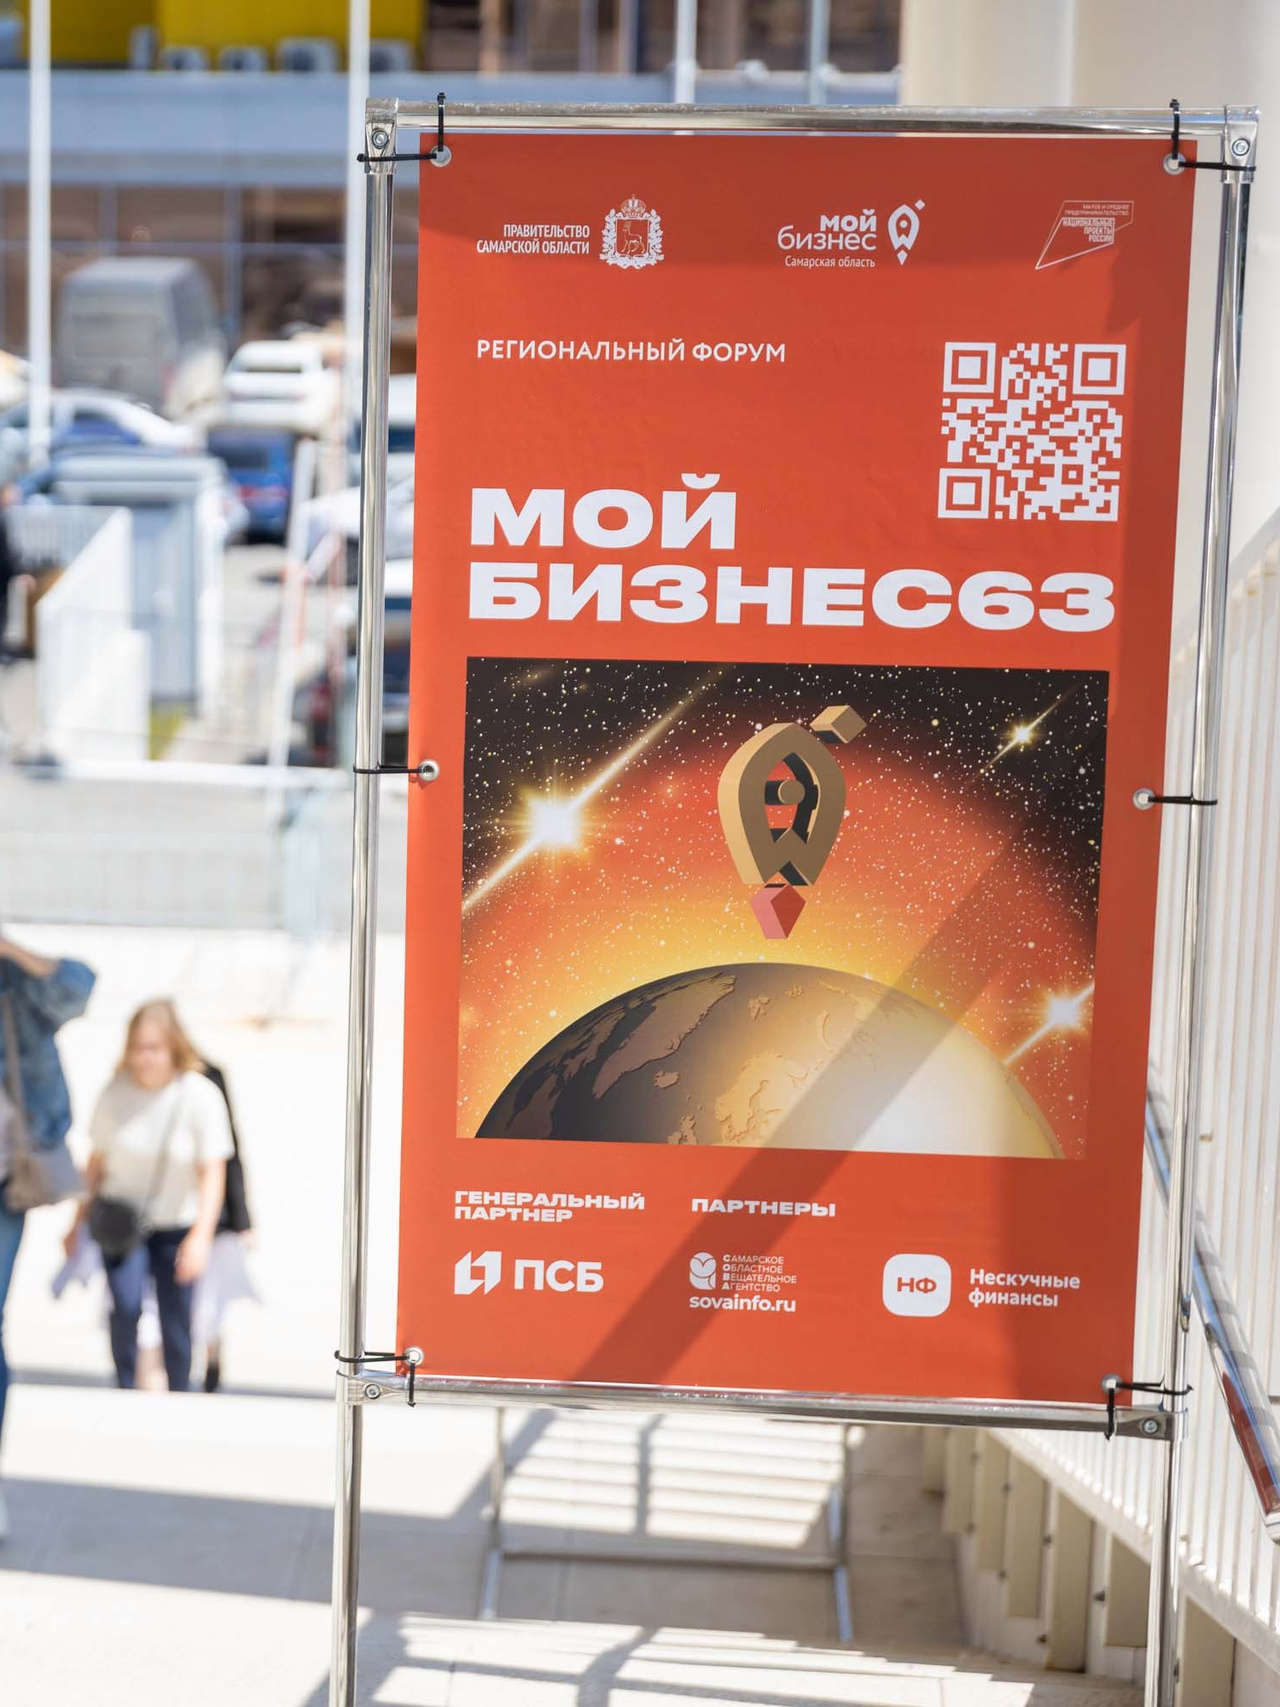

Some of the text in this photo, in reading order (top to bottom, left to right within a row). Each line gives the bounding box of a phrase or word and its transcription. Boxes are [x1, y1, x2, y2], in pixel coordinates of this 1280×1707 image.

[820, 208, 877, 232] мой
[503, 224, 590, 238] ПРАВИТЕЛЬСТВО
[777, 225, 877, 251] бизнес
[476, 238, 590, 254] САМАРСКОЙ ОБЛАСТИ
[785, 255, 876, 269] Самарская область
[477, 338, 786, 362] РЕГИОНАЛЬНЫЙ ФОРУМ
[470, 473, 737, 550] МОЙ
[468, 562, 1115, 632] БИЗНЕС63
[454, 1190, 645, 1210] ГЕНЕРАЛЬНЫЙ
[691, 1198, 837, 1217] ПАРТНЕРЫ
[454, 1206, 573, 1223] ПАРТНЕР
[722, 1254, 784, 1265] САМАРСКОЕ
[722, 1263, 783, 1274] ОБЛАСТНОЕ
[514, 1259, 604, 1293] ПСБ
[723, 1273, 797, 1284] ВЕЩАТЕЛЬНОЕ
[897, 1277, 937, 1293] НФ
[970, 1268, 1080, 1289] Нескучные
[722, 1282, 781, 1292] АГЕНТСТВО
[689, 1293, 796, 1312] sovainfo.ru
[968, 1287, 1058, 1308] финансы
